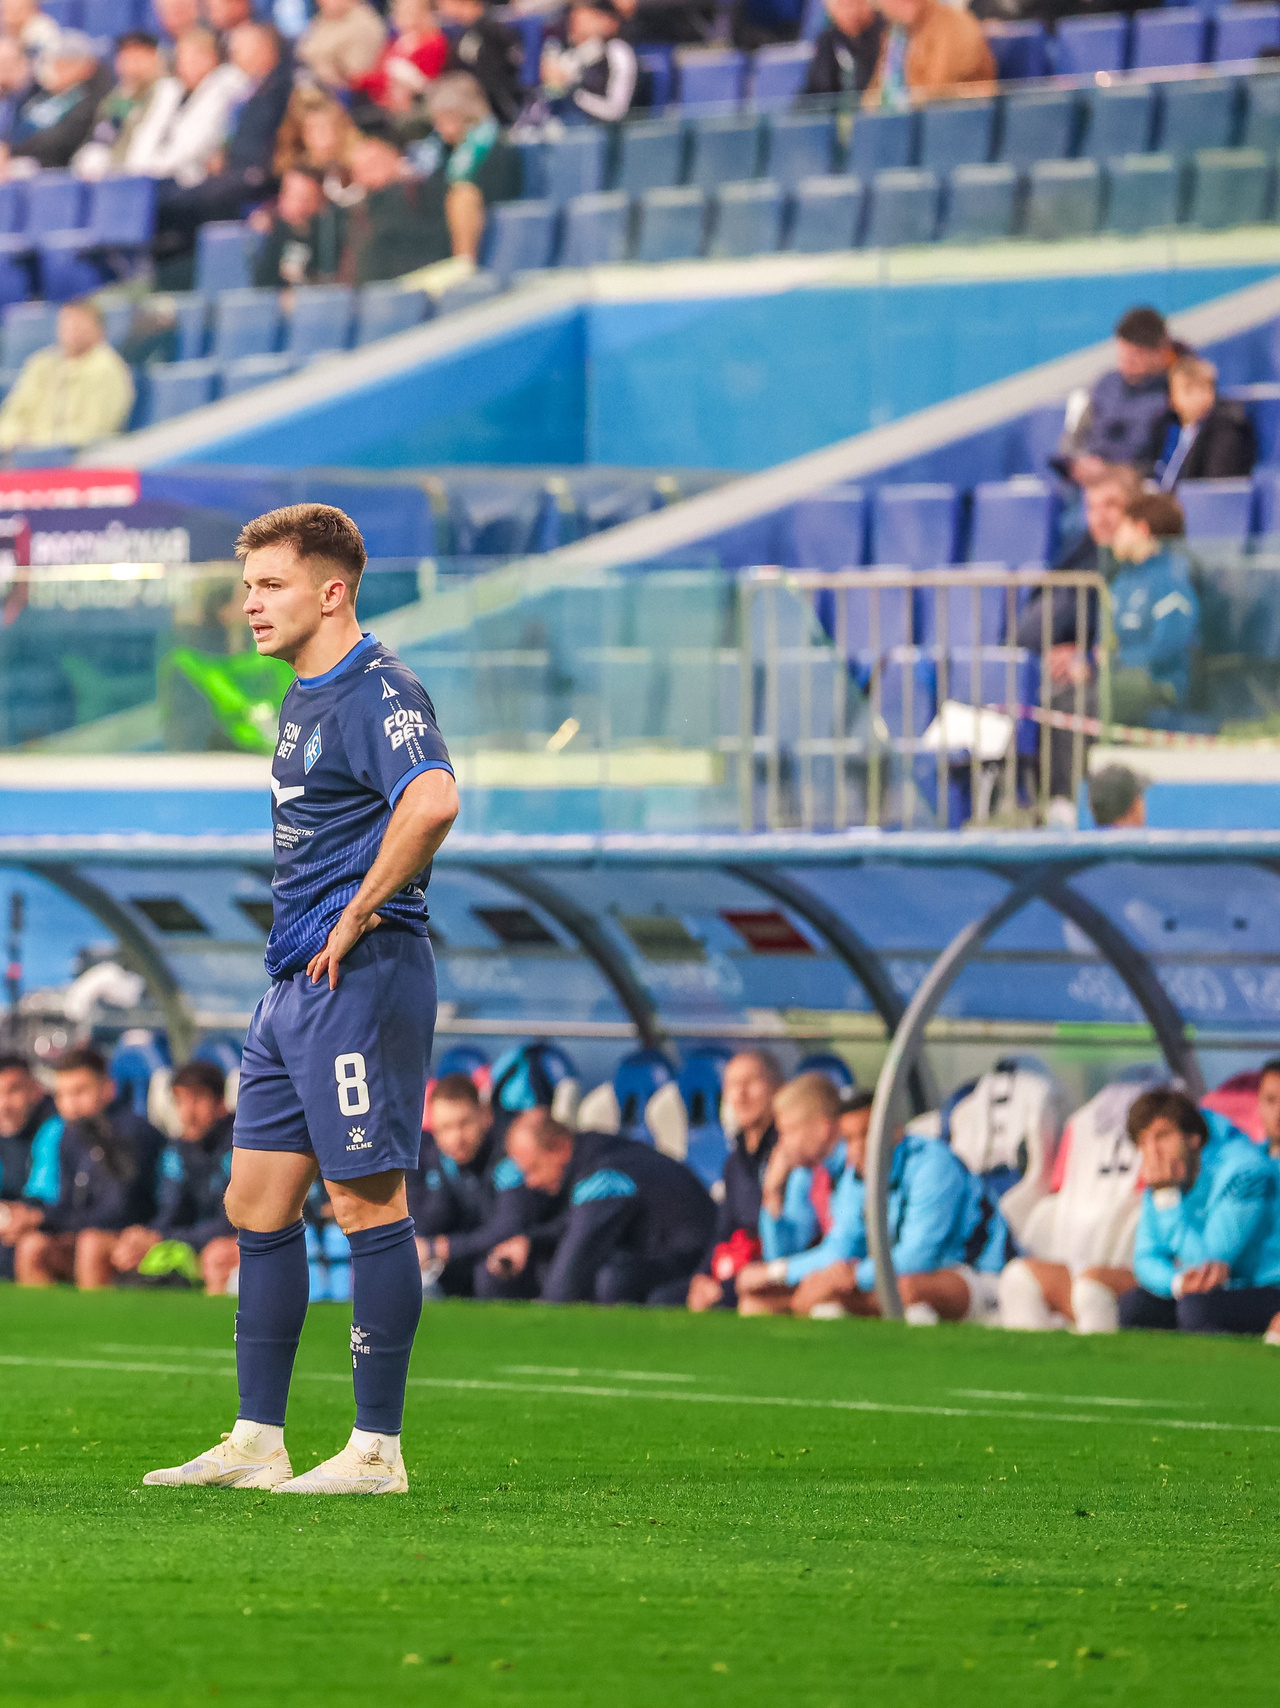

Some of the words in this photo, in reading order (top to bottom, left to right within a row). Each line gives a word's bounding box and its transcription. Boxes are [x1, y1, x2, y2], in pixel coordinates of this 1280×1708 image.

[283, 721, 302, 743] FON
[383, 709, 424, 738] FON
[277, 739, 297, 760] BET
[389, 723, 428, 751] BET
[334, 1052, 371, 1117] 8
[345, 1141, 373, 1152] KELME
